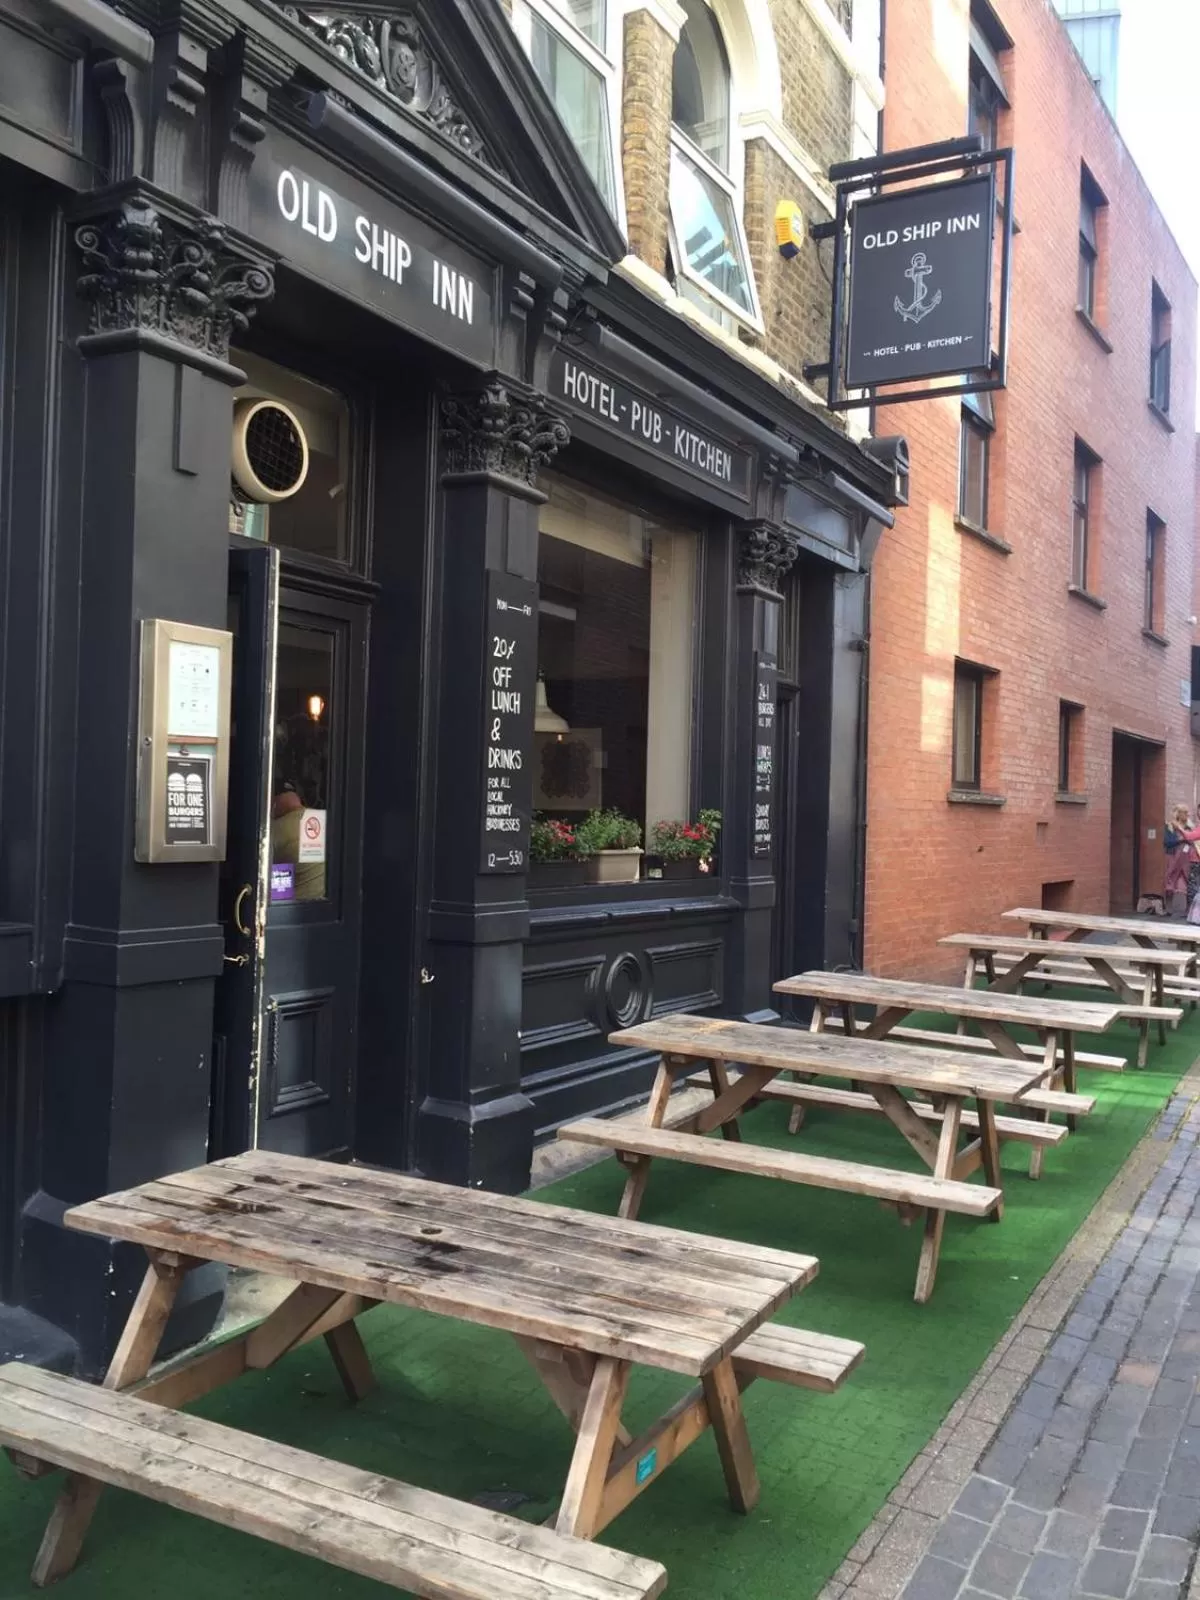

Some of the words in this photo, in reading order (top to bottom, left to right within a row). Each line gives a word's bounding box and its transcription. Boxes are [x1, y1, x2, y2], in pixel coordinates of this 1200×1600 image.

[863, 230, 898, 249] OLD
[902, 221, 942, 242] SHIP
[946, 213, 980, 234] INN
[277, 170, 338, 242] OLD
[354, 216, 412, 285] SHIP
[432, 260, 474, 325] INN
[873, 346, 899, 357] HOTEL
[904, 342, 922, 352] PUB
[927, 336, 962, 348] KITCHEN
[631, 401, 662, 443] PUB
[674, 425, 732, 481] KITCHEN
[493, 667, 512, 688] OFF
[492, 689, 521, 714] LUNCH
[491, 717, 501, 741] &
[488, 746, 522, 770] DRINKS
[487, 776, 500, 789] FOR
[501, 776, 511, 789] ALL
[168, 792, 186, 806] FOR
[187, 793, 204, 807] ONE
[487, 791, 504, 803] LOCAL
[168, 806, 204, 817] BURGERS
[485, 817, 521, 832] BUSINESSES
